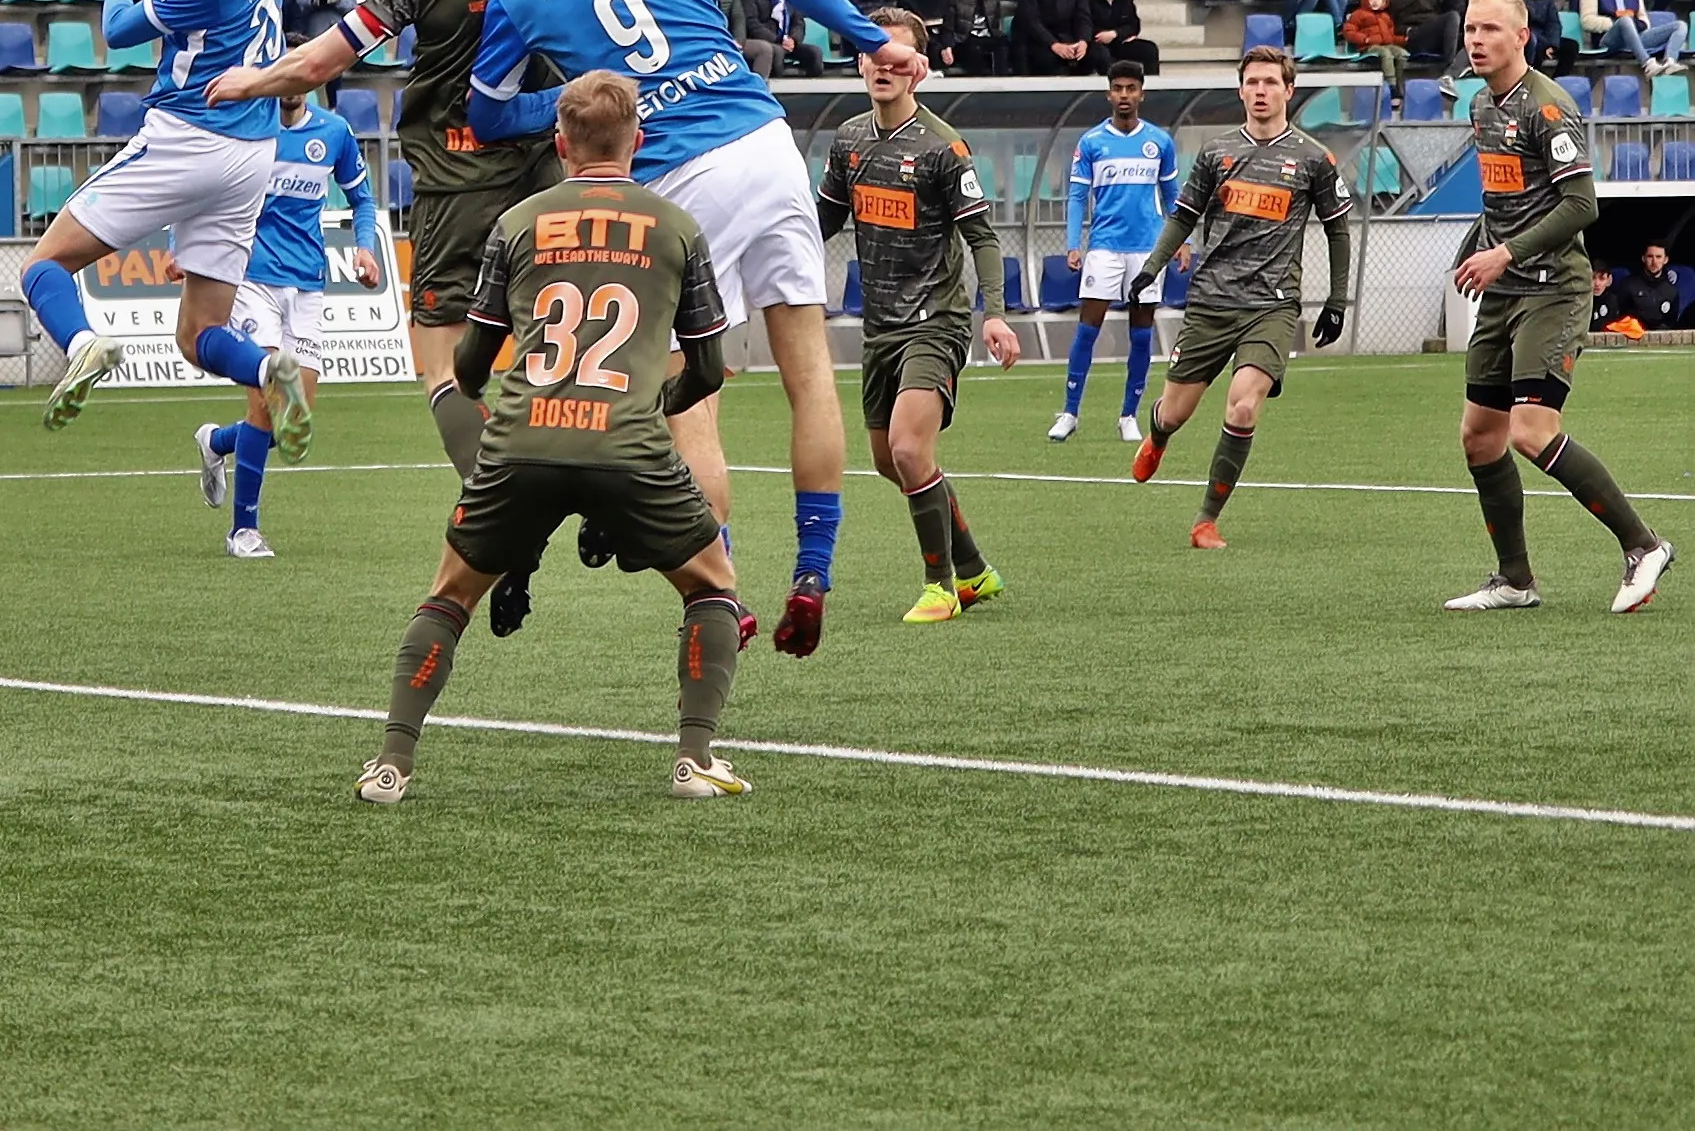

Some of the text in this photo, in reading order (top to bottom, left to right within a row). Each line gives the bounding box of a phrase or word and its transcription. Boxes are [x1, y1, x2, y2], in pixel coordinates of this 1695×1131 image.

[638, 52, 739, 122] ETCITY.NL
[864, 195, 910, 220] FIER
[1234, 189, 1284, 214] FIER
[535, 208, 657, 252] BTT
[534, 249, 639, 266] WE LEAD THE WAY
[321, 338, 404, 350] RPAKKINGEN
[525, 281, 640, 393] 32
[321, 355, 408, 377] PRIJSD!
[529, 397, 612, 431] BOSCH
